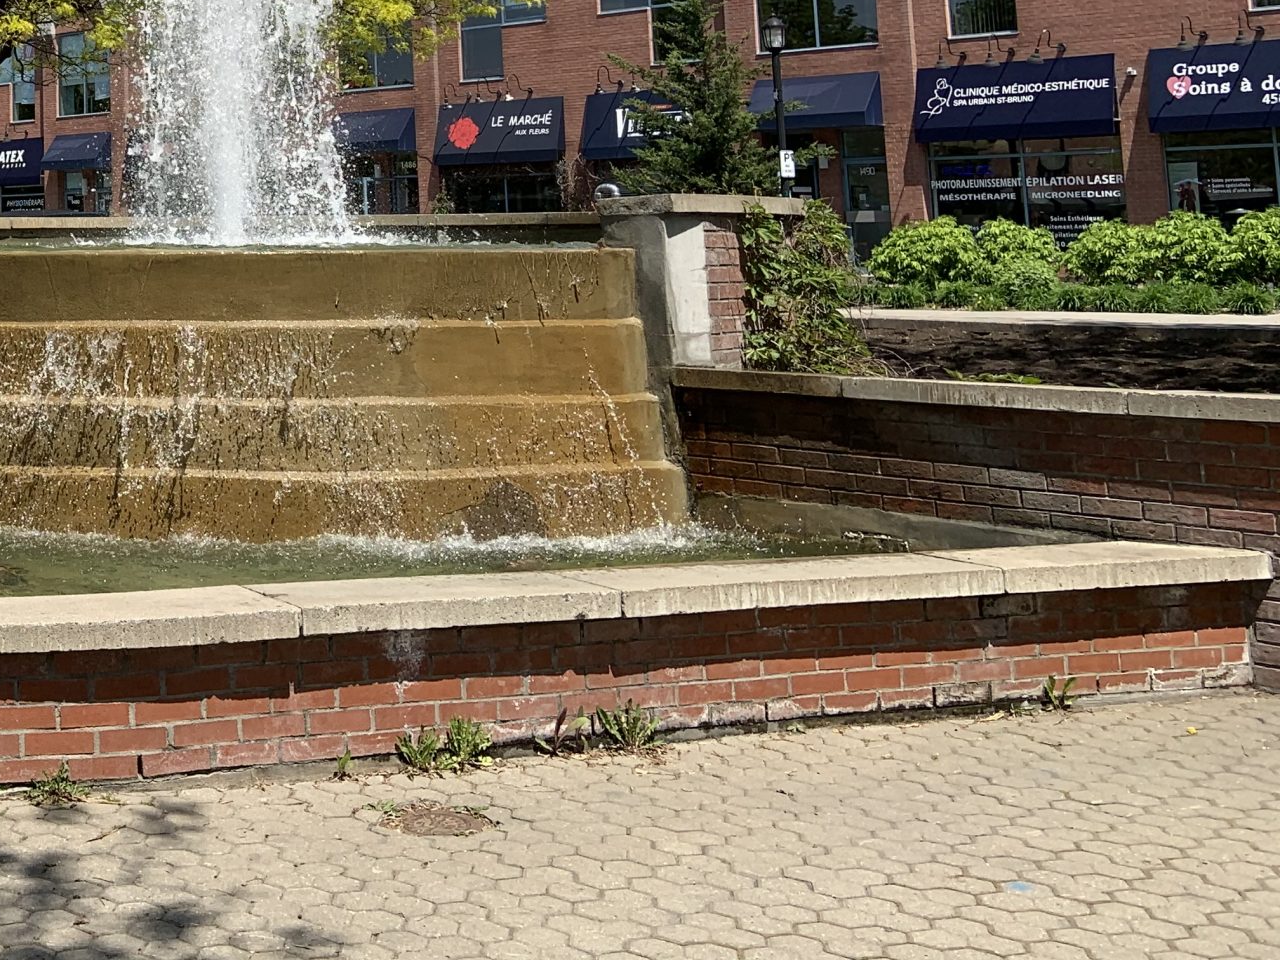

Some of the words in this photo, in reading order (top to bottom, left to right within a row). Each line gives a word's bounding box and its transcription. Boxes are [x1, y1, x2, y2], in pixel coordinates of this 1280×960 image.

[1172, 62, 1239, 77] Groupe
[953, 86, 1000, 98] CLINIQUE
[1002, 78, 1110, 95] MÉDICO-ESTHÉTIQUE
[1172, 80, 1231, 96] Soins
[1240, 77, 1252, 92] à
[953, 99, 967, 107] SPA
[968, 97, 995, 106] URBAIN
[997, 95, 1034, 104] ST-BRUNO
[1261, 93, 1280, 105] 45
[491, 116, 504, 127] LE
[509, 110, 552, 126] MARCHÉ
[931, 177, 1022, 190] PHOTORAJEUNISSEMENT
[1026, 175, 1085, 188] ÉPILATION
[1087, 174, 1124, 185] LASER
[939, 192, 1017, 201] MÉSOTHÉRAPIE
[1031, 190, 1121, 199] MICRONEEDLING
[1052, 231, 1078, 239] pilation
